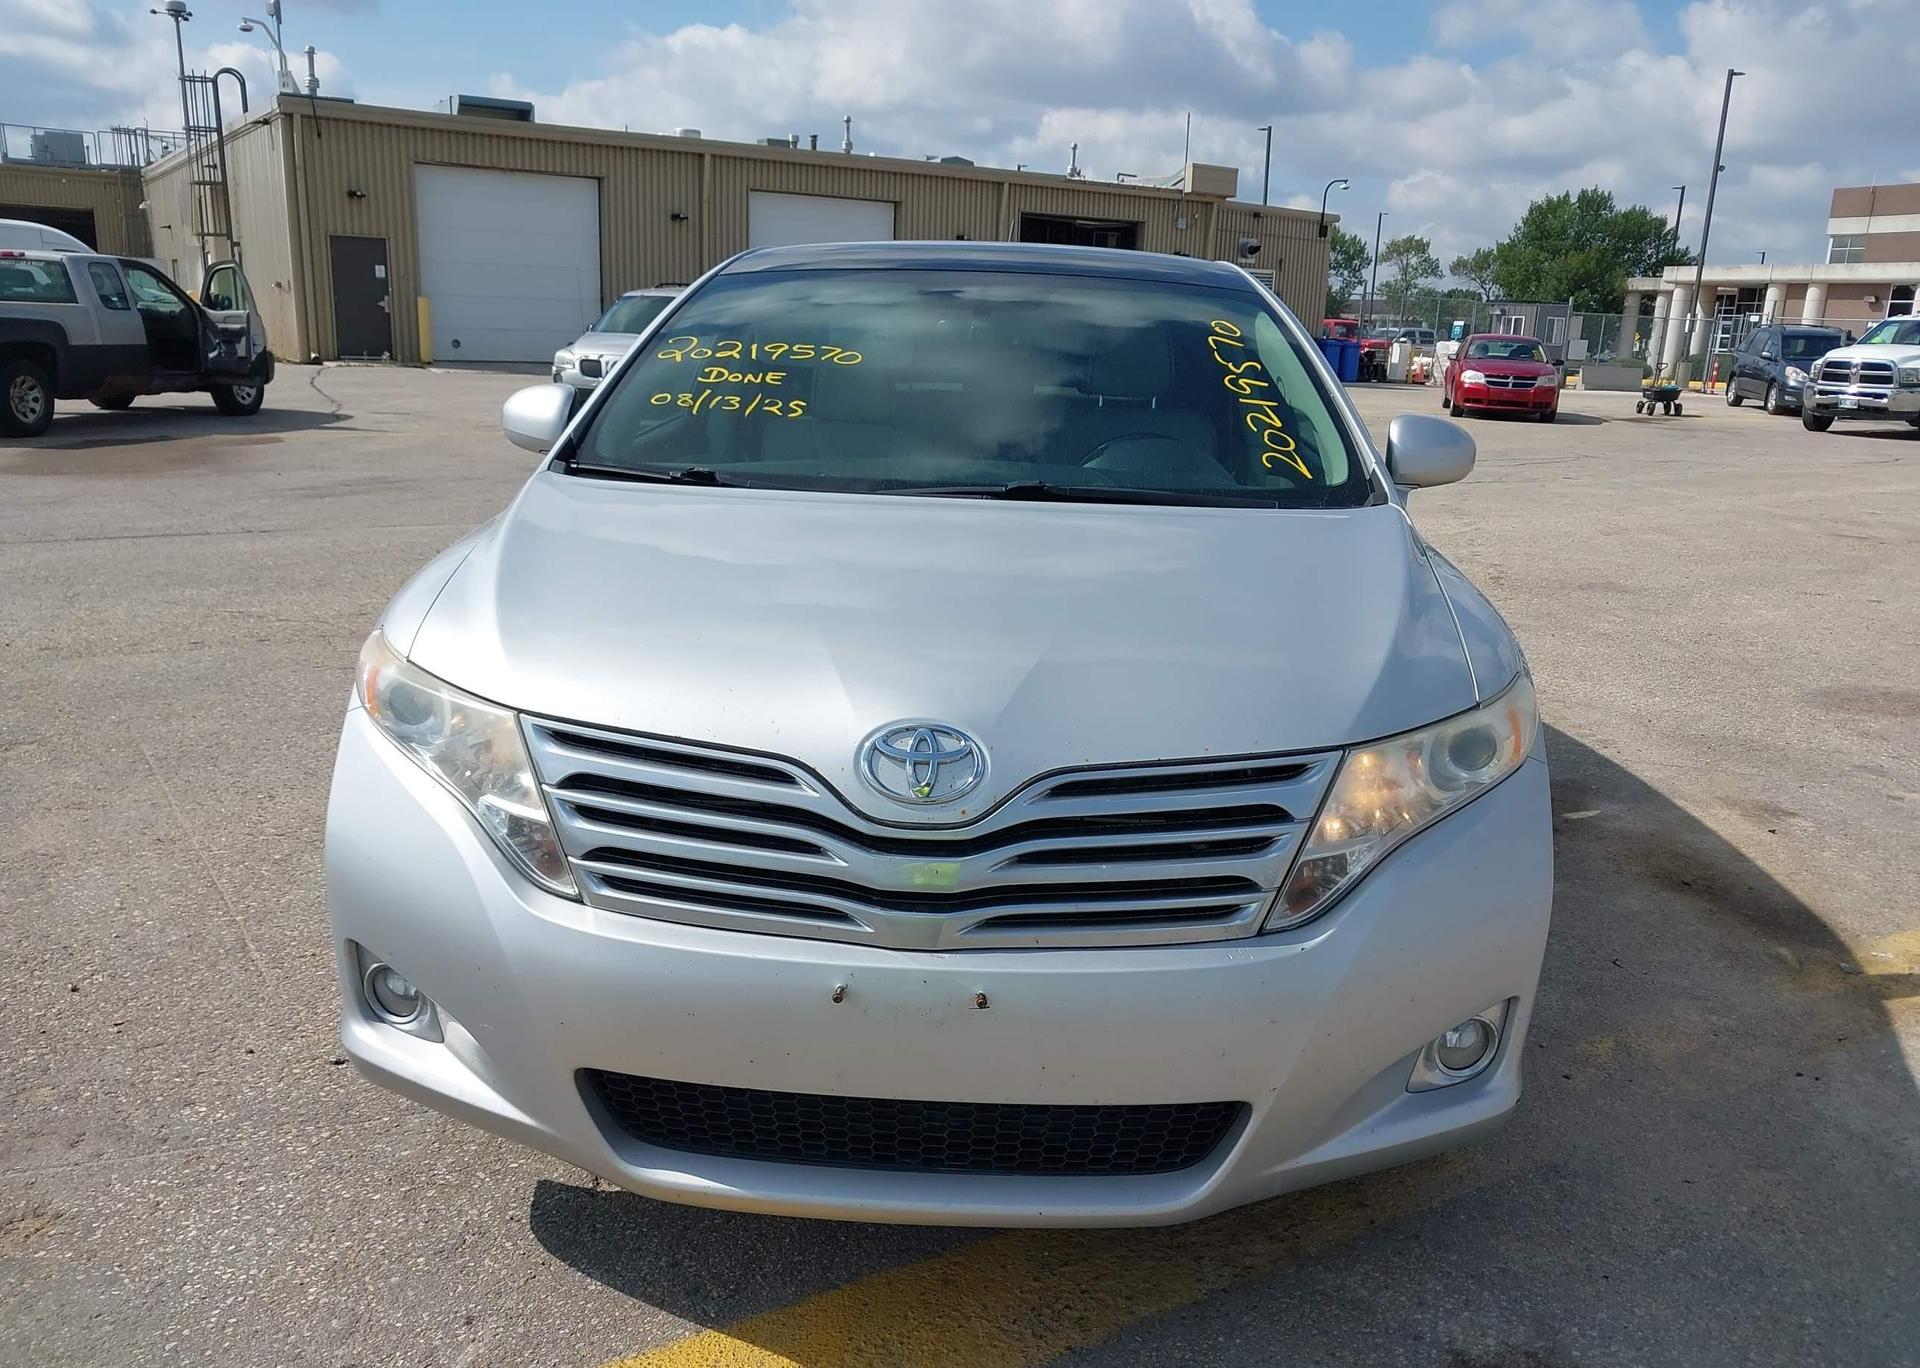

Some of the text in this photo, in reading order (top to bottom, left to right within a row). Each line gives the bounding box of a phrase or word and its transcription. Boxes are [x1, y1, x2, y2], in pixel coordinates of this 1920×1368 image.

[657, 336, 863, 365] 20219570
[697, 366, 787, 385] DONE
[650, 389, 808, 418] 08/13/25
[1207, 320, 1314, 480] 20219570
